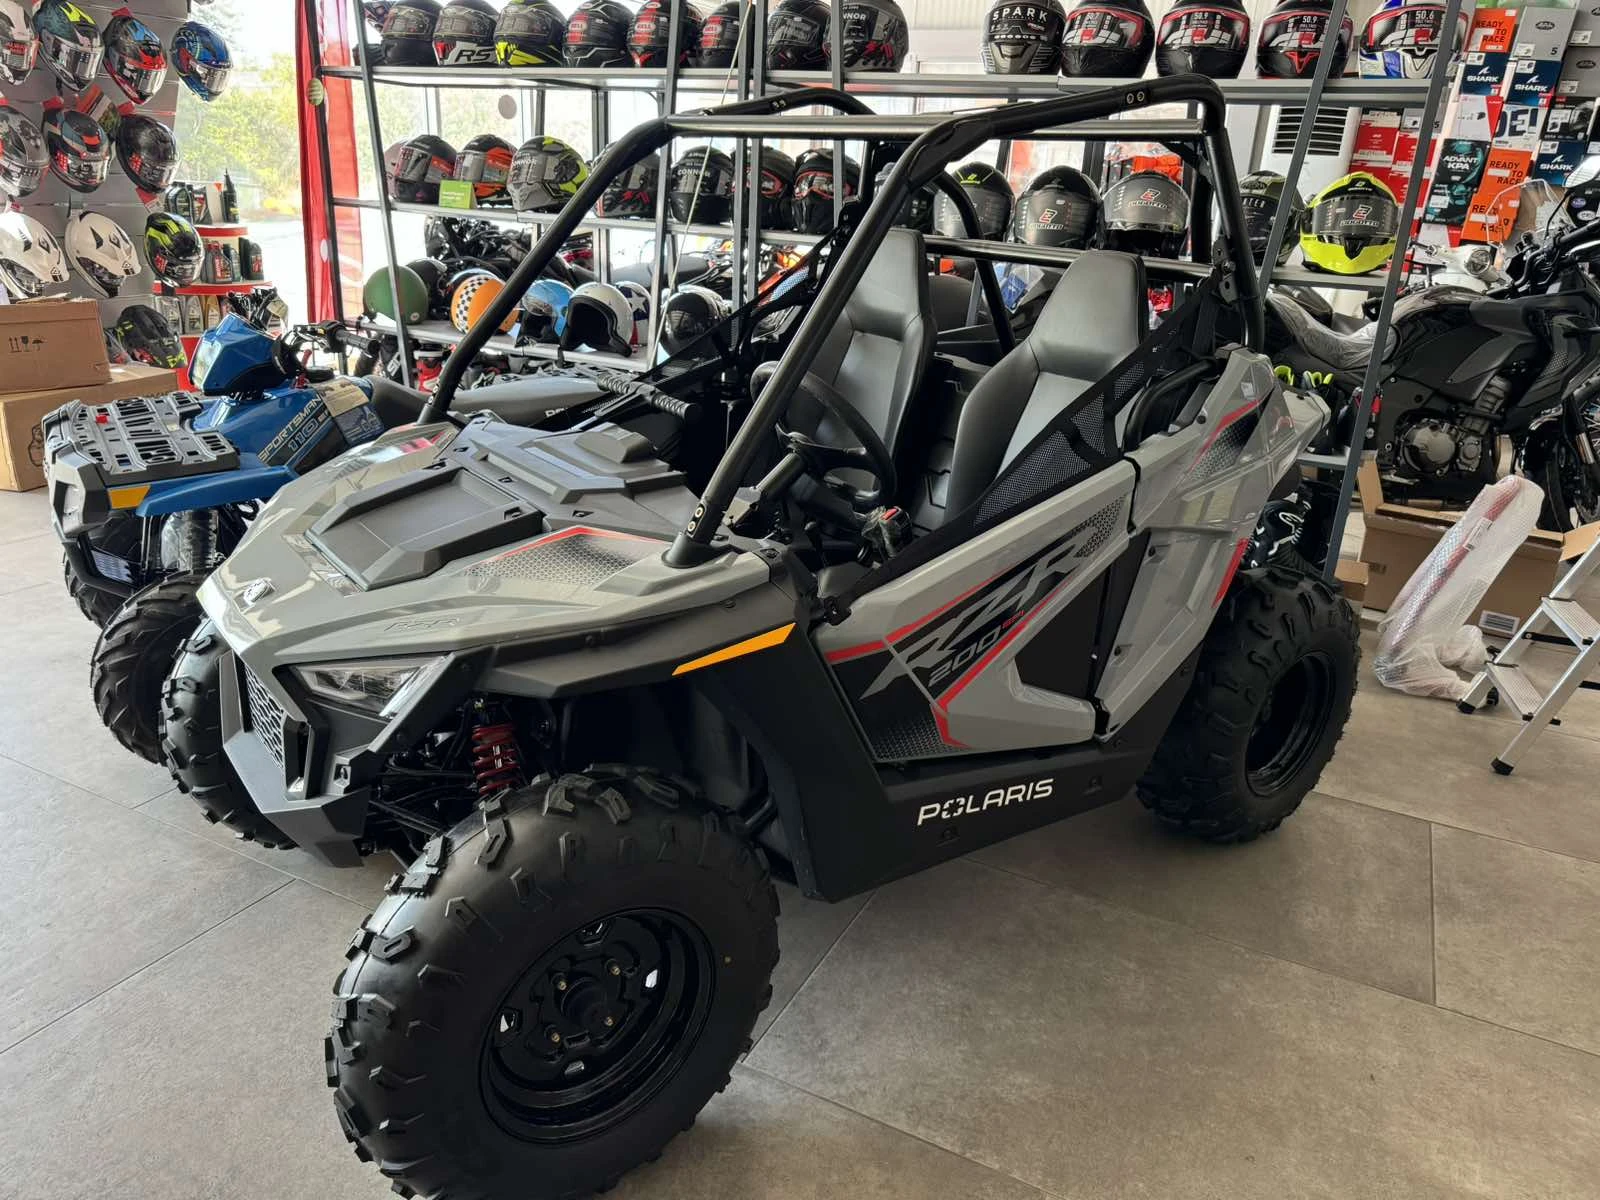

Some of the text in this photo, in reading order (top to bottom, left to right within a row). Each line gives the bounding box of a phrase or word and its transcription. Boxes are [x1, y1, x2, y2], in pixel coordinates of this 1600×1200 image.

[992, 7, 1047, 22] SPARK
[1302, 15, 1318, 23] 50.9
[1415, 10, 1434, 20] 50.6
[1496, 28, 1507, 36] TO
[1482, 35, 1505, 43] RACE
[455, 48, 496, 63] RS
[1551, 47, 1558, 56] 5
[1514, 84, 1548, 92] SHARK
[1490, 160, 1520, 169] READY
[1540, 163, 1573, 171] SHARK
[1512, 170, 1523, 178] TO
[257, 393, 322, 461] SPORTSMAN
[928, 628, 1002, 688] 200
[917, 778, 1055, 826] POLARIS
